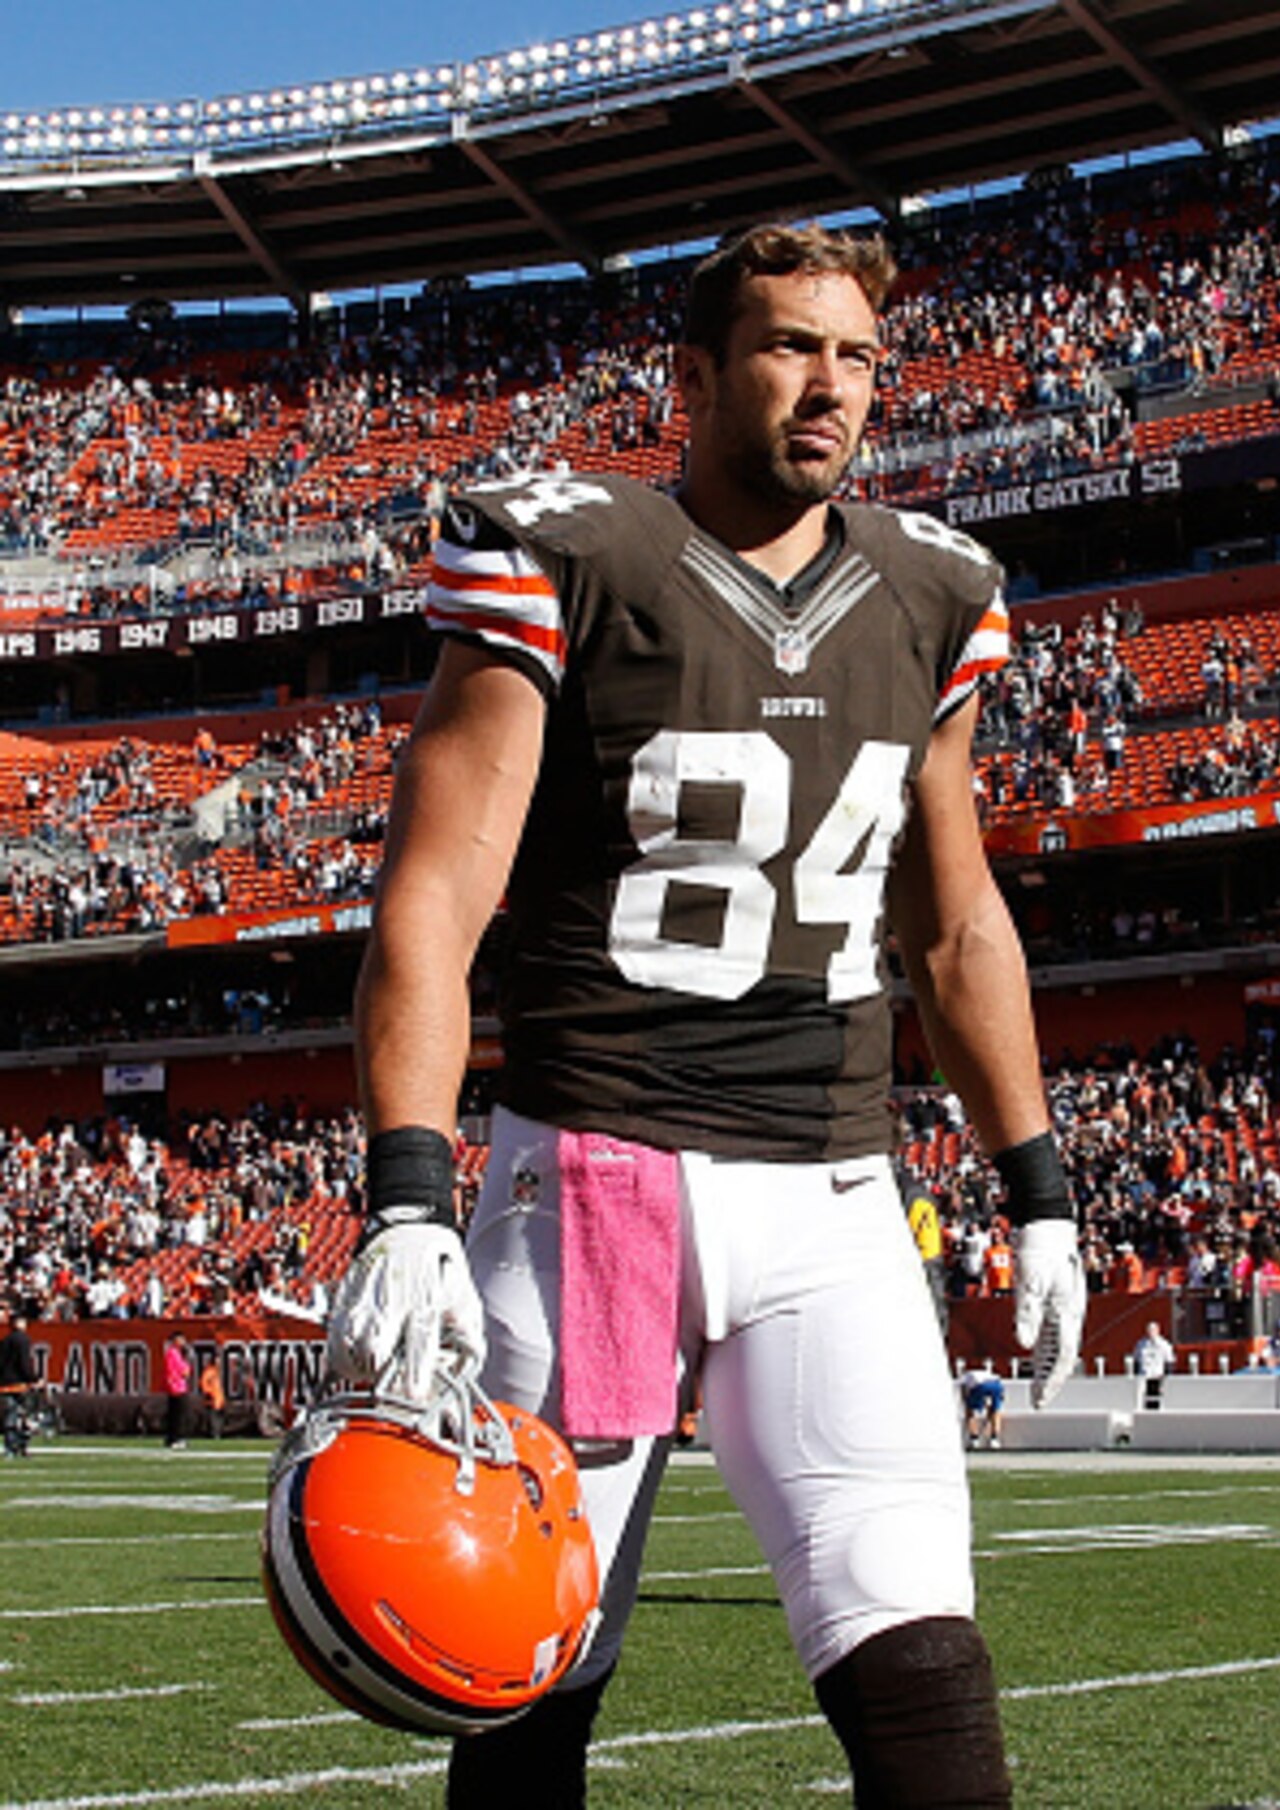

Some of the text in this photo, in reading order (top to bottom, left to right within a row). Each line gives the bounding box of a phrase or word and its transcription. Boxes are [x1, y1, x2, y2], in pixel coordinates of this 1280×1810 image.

[946, 486, 1032, 527] FRANK
[119, 620, 169, 648] 1947
[608, 728, 911, 1005] 84
